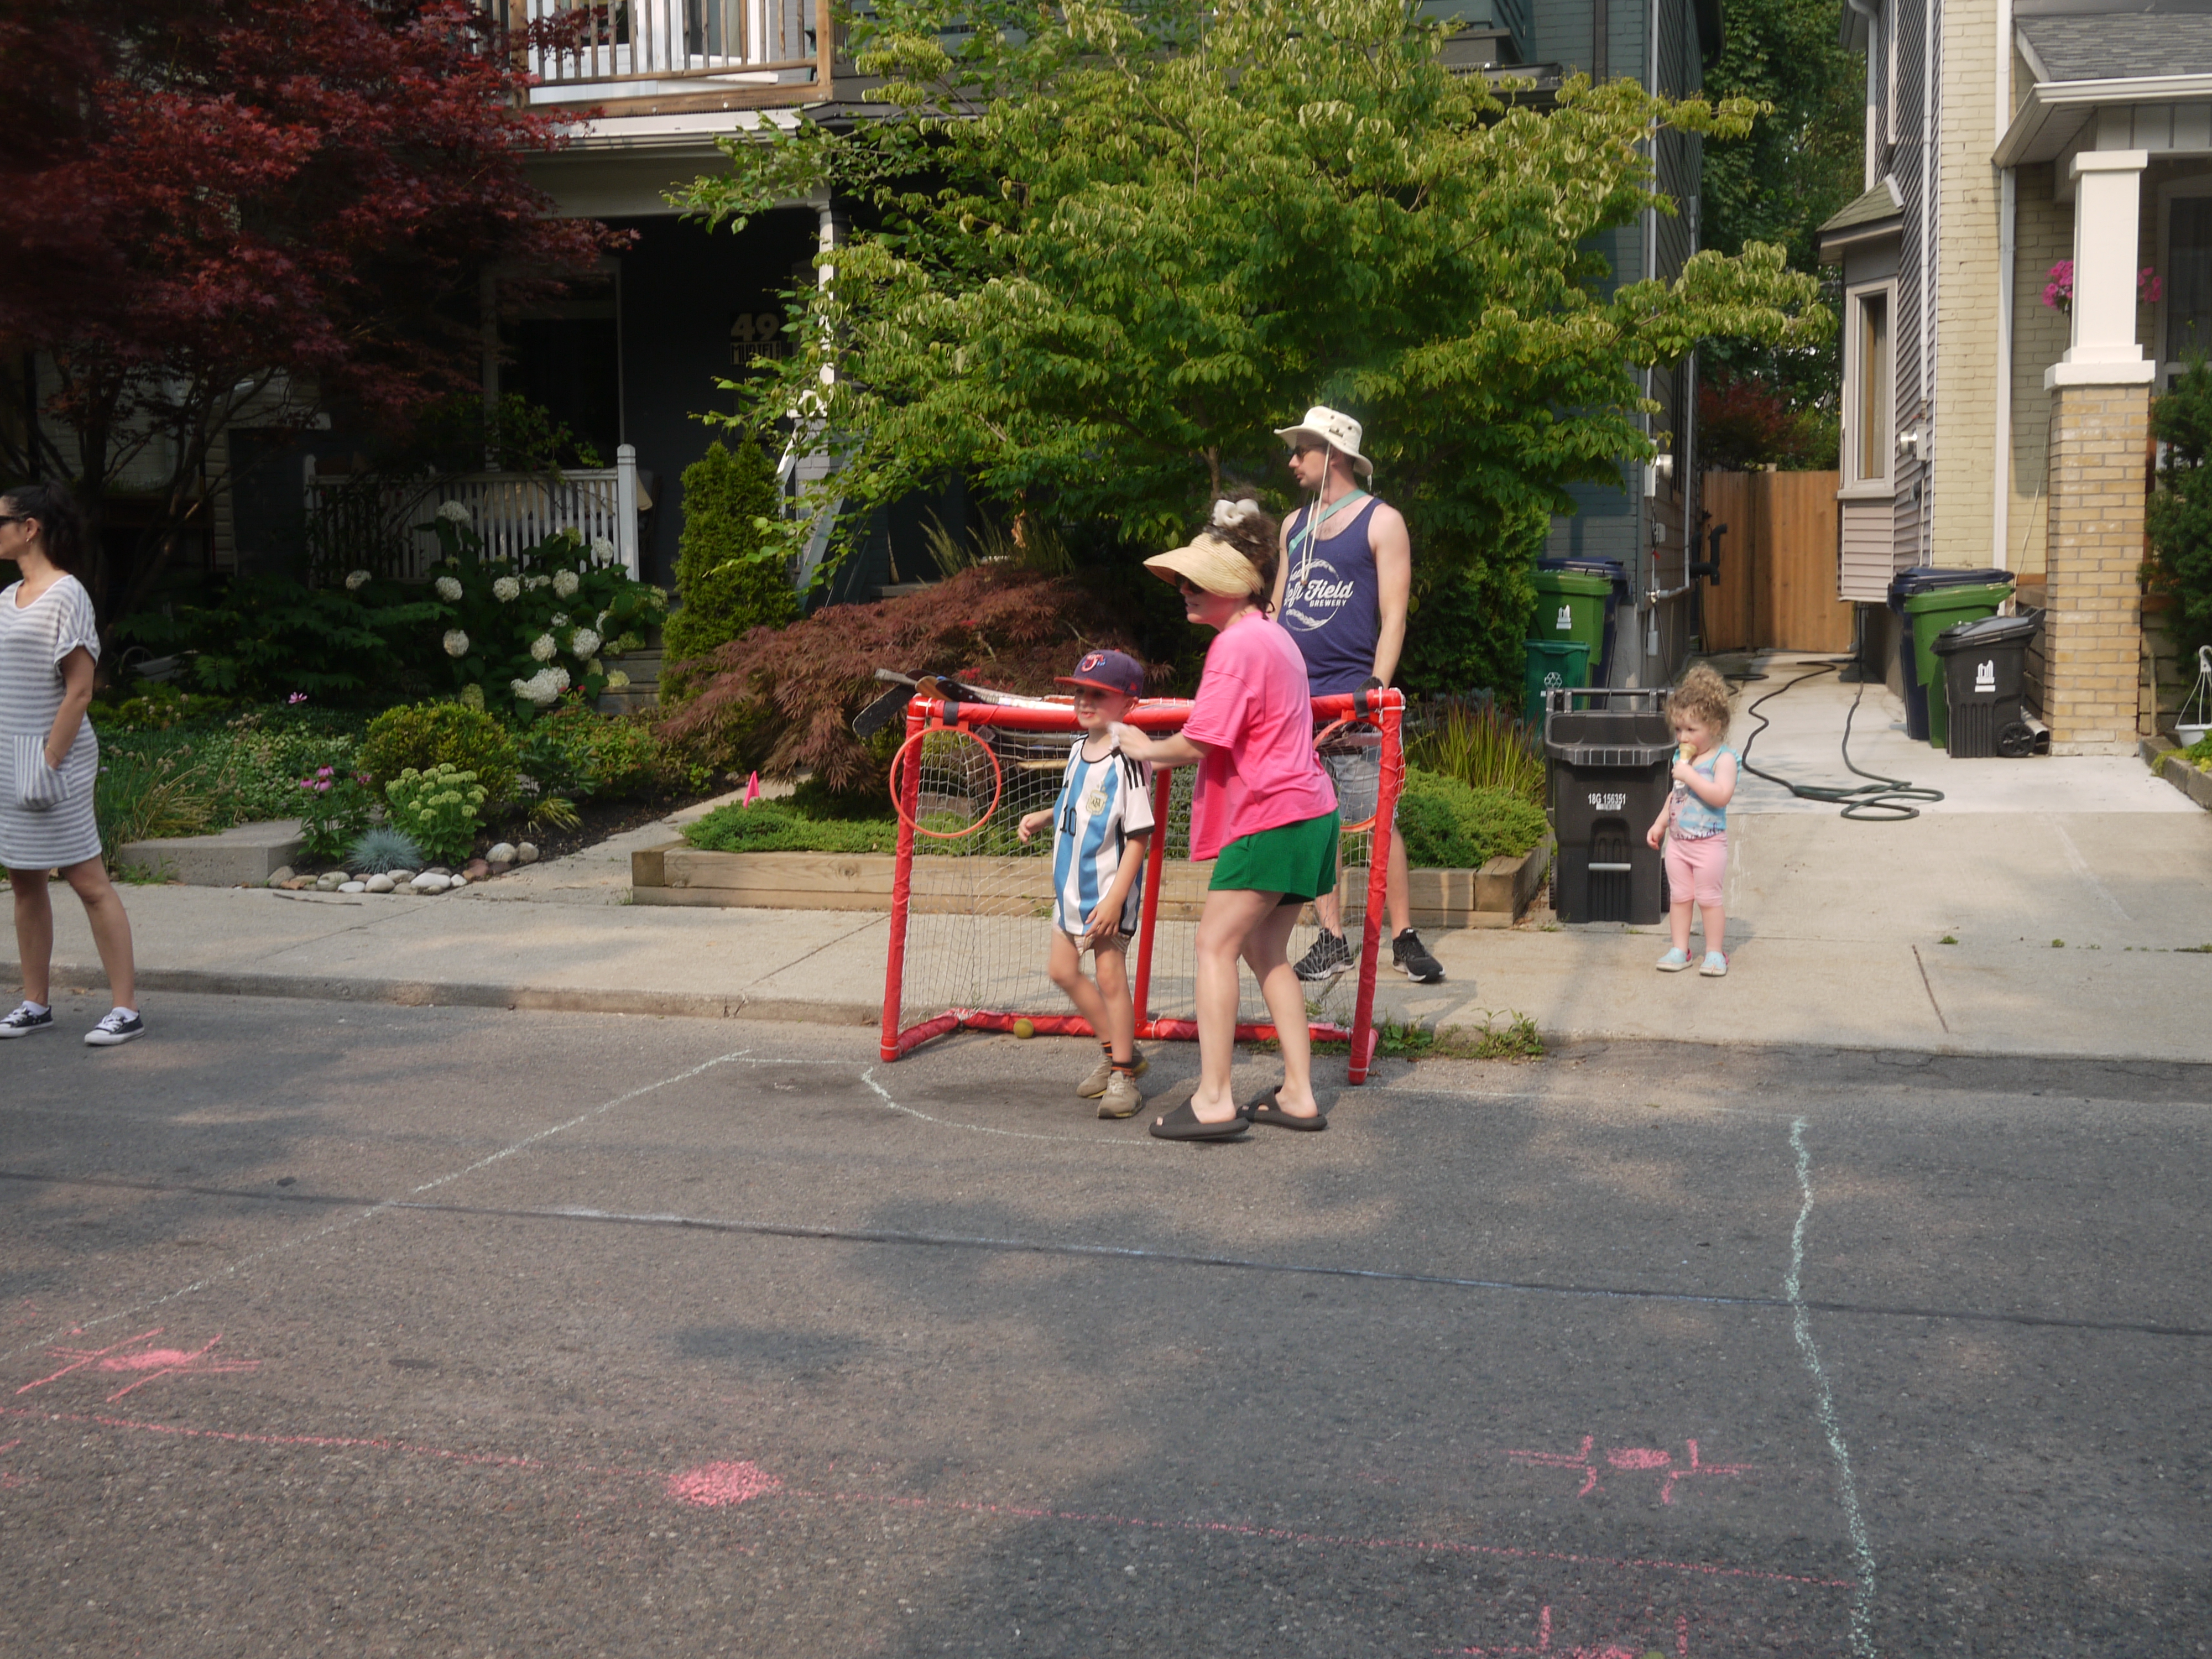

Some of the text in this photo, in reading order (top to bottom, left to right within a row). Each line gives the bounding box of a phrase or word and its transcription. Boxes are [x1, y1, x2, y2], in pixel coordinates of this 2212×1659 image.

[731, 312, 780, 341] 49
[1304, 579, 1354, 602] Field
[1309, 599, 1347, 608] BREWERY
[1588, 792, 1626, 805] 18G 156351
[1059, 804, 1077, 837] 10
